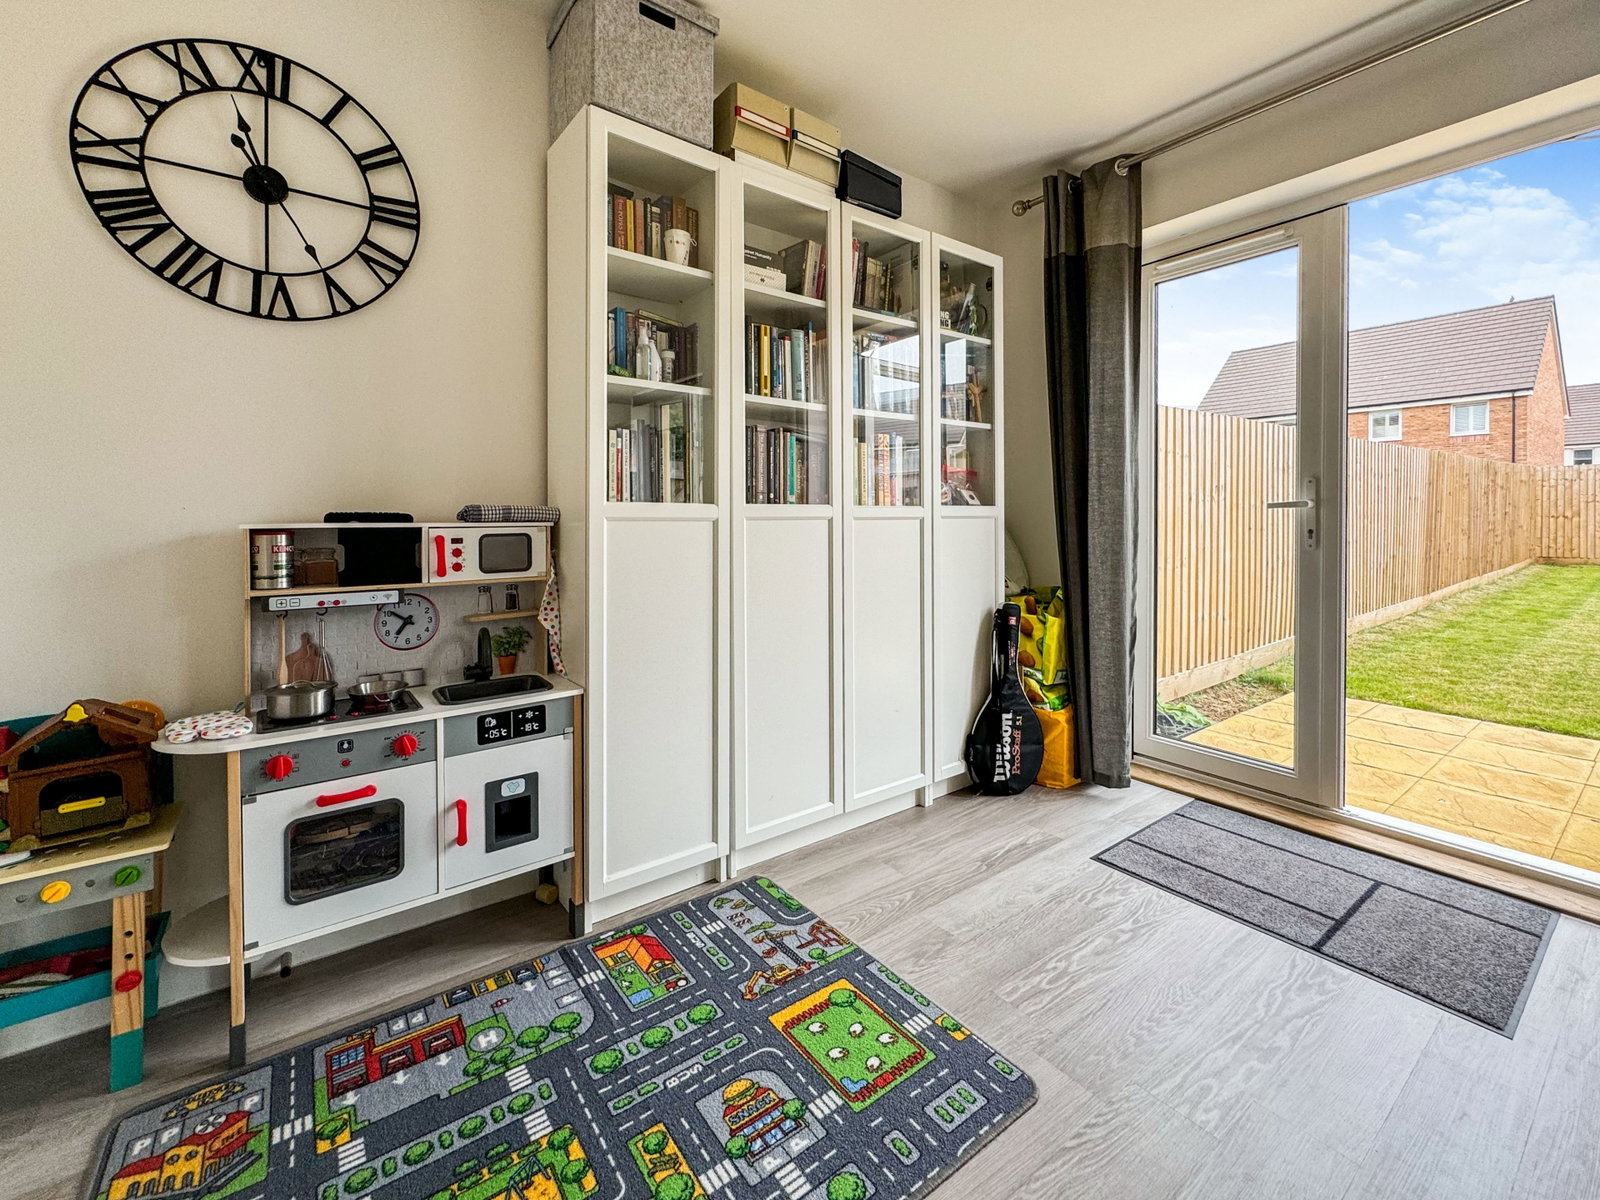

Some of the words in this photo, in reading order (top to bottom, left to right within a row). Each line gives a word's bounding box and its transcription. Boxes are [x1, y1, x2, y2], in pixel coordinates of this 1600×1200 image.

[477, 1030, 498, 1048] H
[665, 1063, 704, 1089] BUS
[244, 1093, 260, 1111] P
[729, 1093, 775, 1126] SNACK
[161, 1126, 180, 1145] P
[790, 1136, 811, 1153] P
[131, 1137, 151, 1157] P
[763, 1155, 783, 1172] P
